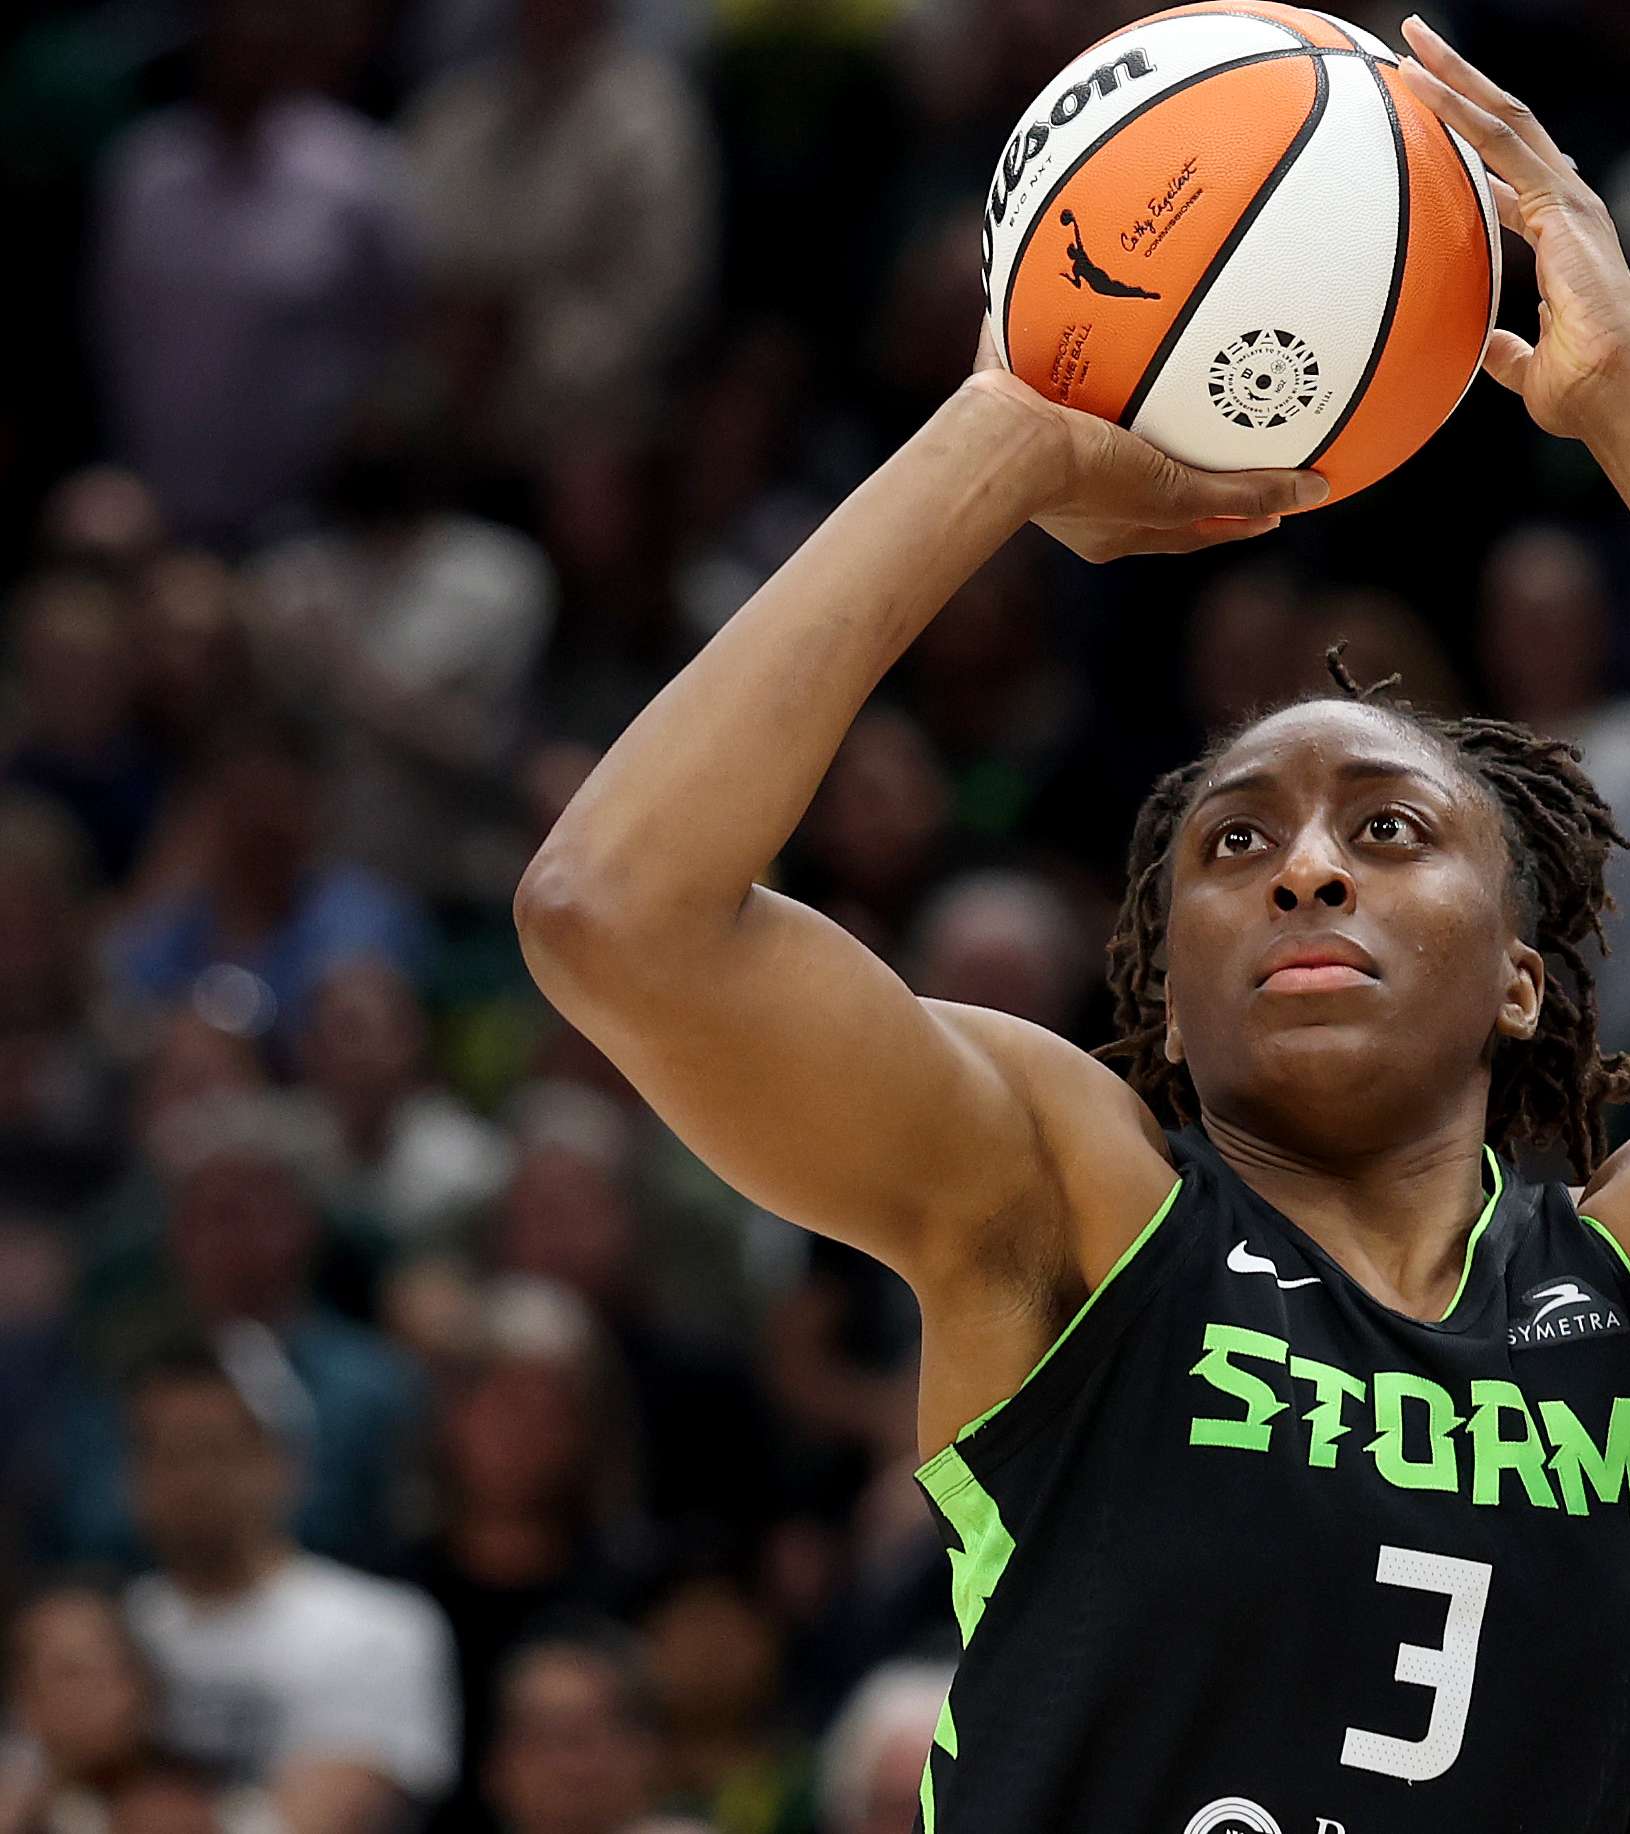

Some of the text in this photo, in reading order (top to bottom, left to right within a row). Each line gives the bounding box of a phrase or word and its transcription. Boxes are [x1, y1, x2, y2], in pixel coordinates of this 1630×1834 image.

[1071, 323, 1092, 360] BALL
[1507, 1309, 1621, 1346] SYMETRA
[1340, 1545, 1493, 1782] 3
